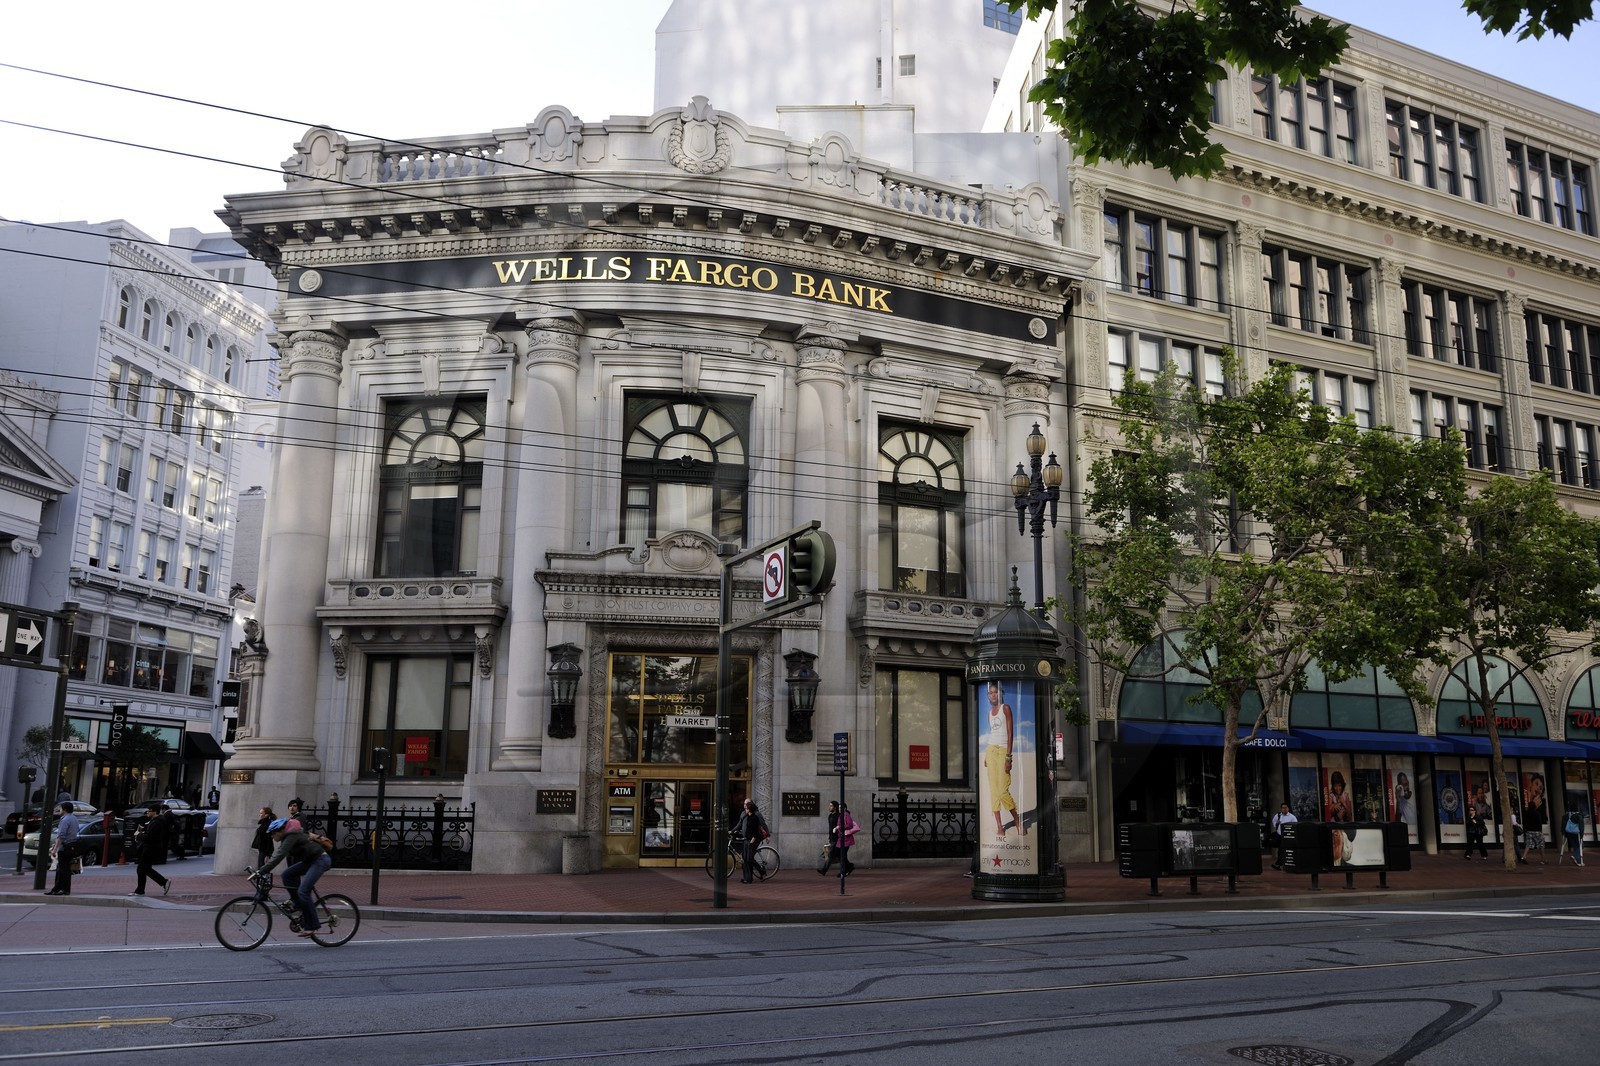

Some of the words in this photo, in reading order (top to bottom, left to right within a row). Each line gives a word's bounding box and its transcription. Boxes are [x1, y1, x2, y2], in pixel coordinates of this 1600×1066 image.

[492, 256, 632, 284] WELLS
[645, 257, 779, 291] FARGO
[791, 272, 893, 313] BANK
[594, 598, 621, 608] UNION
[624, 600, 649, 609] TRUST
[651, 601, 691, 611] COMPANY
[694, 602, 706, 612] OF
[16, 632, 27, 640] ONE
[136, 659, 150, 668] cinta
[970, 665, 980, 674] SAN
[981, 663, 1026, 673] FRANCISCO
[655, 693, 705, 704] WELLS
[674, 717, 710, 726] MARKET
[1494, 715, 1533, 730] PHOTO
[111, 712, 124, 747] bebe
[1264, 738, 1287, 747] DOLCI
[613, 787, 631, 795] ATM
